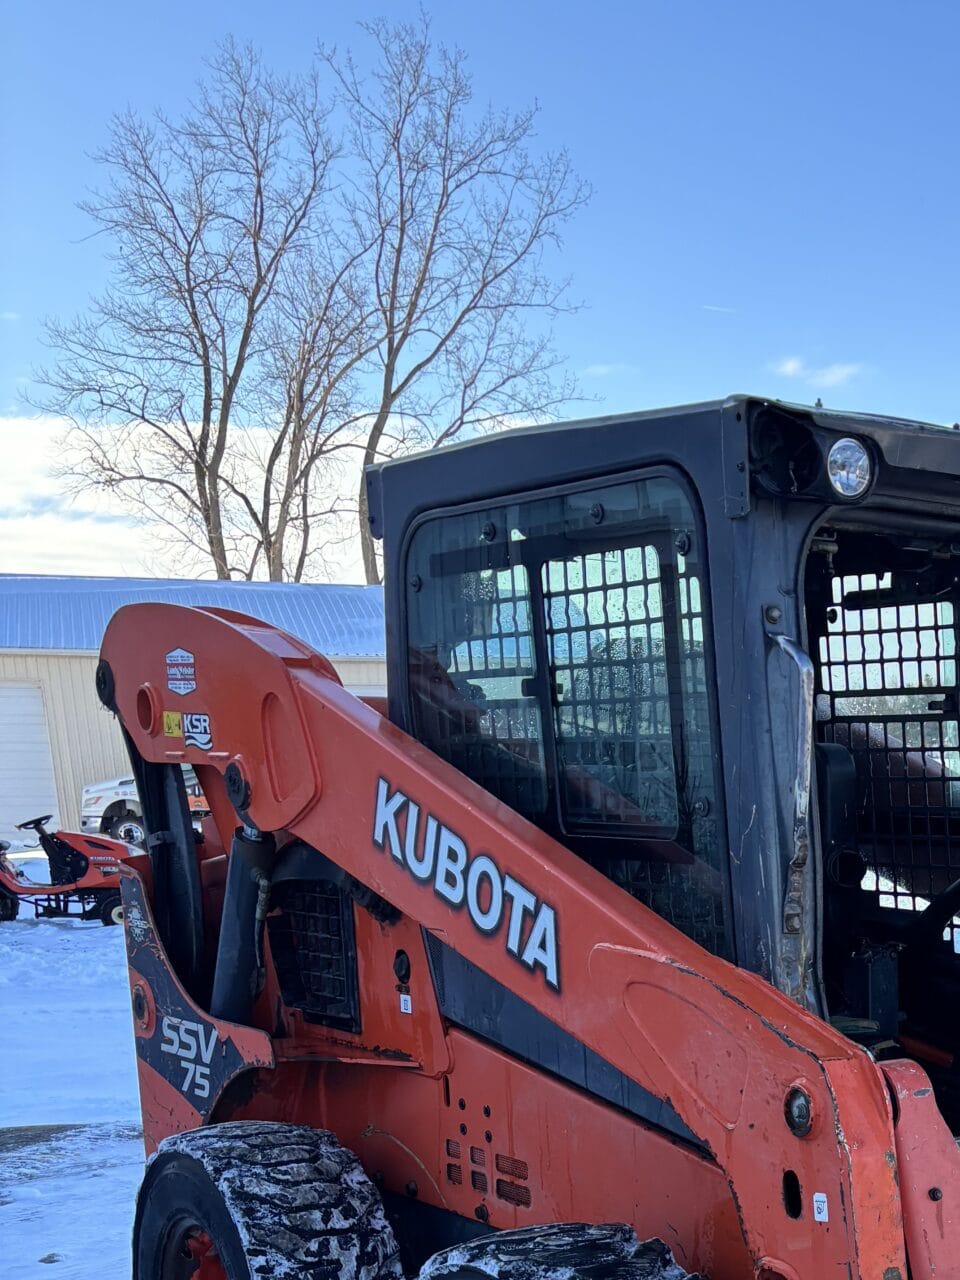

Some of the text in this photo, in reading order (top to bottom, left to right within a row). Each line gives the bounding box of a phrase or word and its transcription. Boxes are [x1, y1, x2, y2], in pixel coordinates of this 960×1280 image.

[184, 714, 210, 733] KSR
[374, 777, 559, 990] KUBOTA
[161, 1016, 218, 1065] SSV
[181, 1060, 210, 1098] 75
